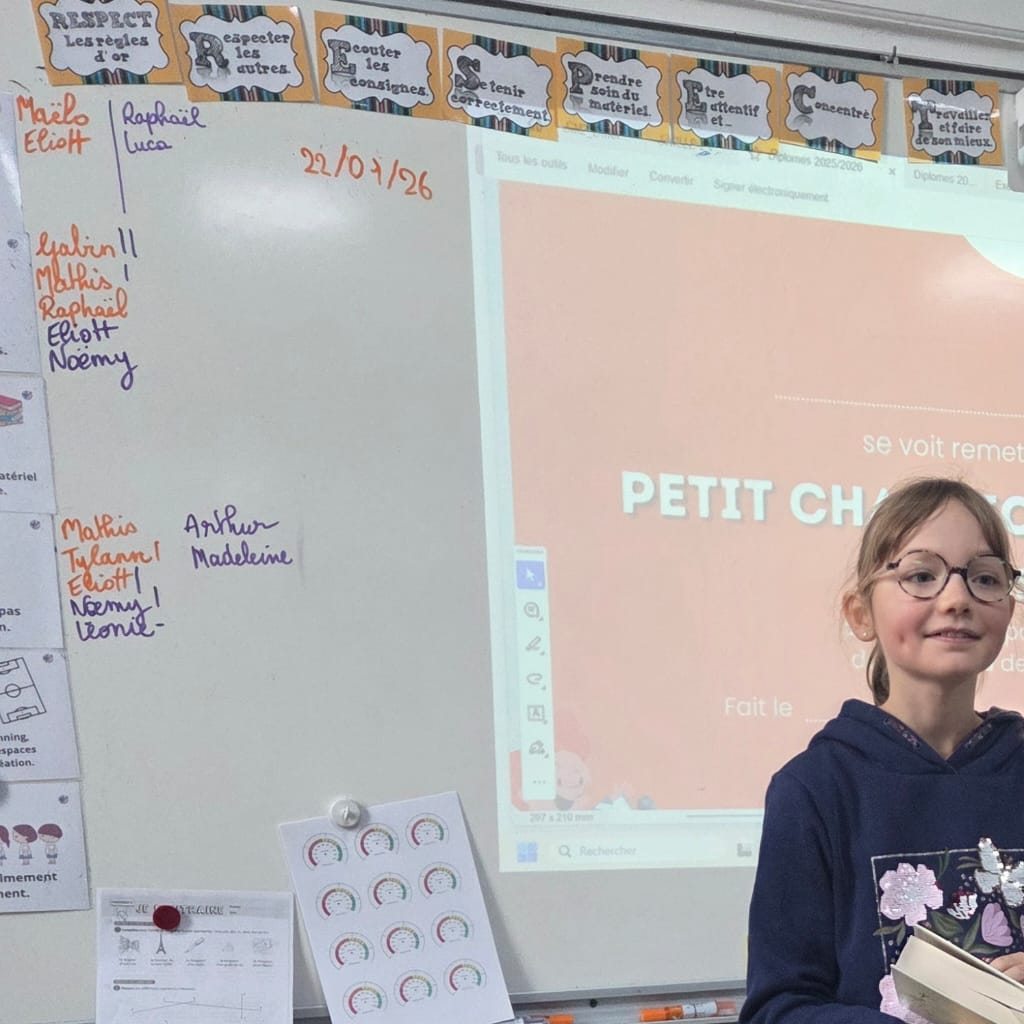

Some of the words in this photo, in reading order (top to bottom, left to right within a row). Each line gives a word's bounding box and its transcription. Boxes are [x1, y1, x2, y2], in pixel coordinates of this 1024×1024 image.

[49, 10, 152, 30] RESPECT
[65, 34, 93, 47] Les
[95, 32, 149, 50] règles
[189, 31, 290, 69] Respecter
[235, 46, 261, 60] les
[366, 56, 390, 72] les
[236, 61, 291, 75] autres.
[568, 60, 643, 95] Prendre
[350, 76, 429, 98] consignes.
[490, 80, 526, 99] tenir
[590, 85, 620, 99] soin
[621, 88, 640, 102] du
[450, 92, 550, 123] correctement.
[711, 101, 760, 118] attentif
[939, 124, 951, 134] et
[952, 122, 983, 135] faire
[123, 130, 173, 154] Luca
[915, 134, 930, 146] de
[931, 135, 953, 147] son
[954, 135, 993, 148] mieux.
[36, 264, 113, 297] Mathis
[862, 434, 892, 456] se
[898, 434, 945, 459] voit
[621, 470, 774, 522] PETIT
[61, 514, 138, 543] Mathis
[184, 504, 280, 538] Arthur
[191, 540, 294, 570] Madeleine
[723, 696, 768, 718] Fait
[773, 696, 794, 718] le
[579, 845, 637, 858] Rechercher
